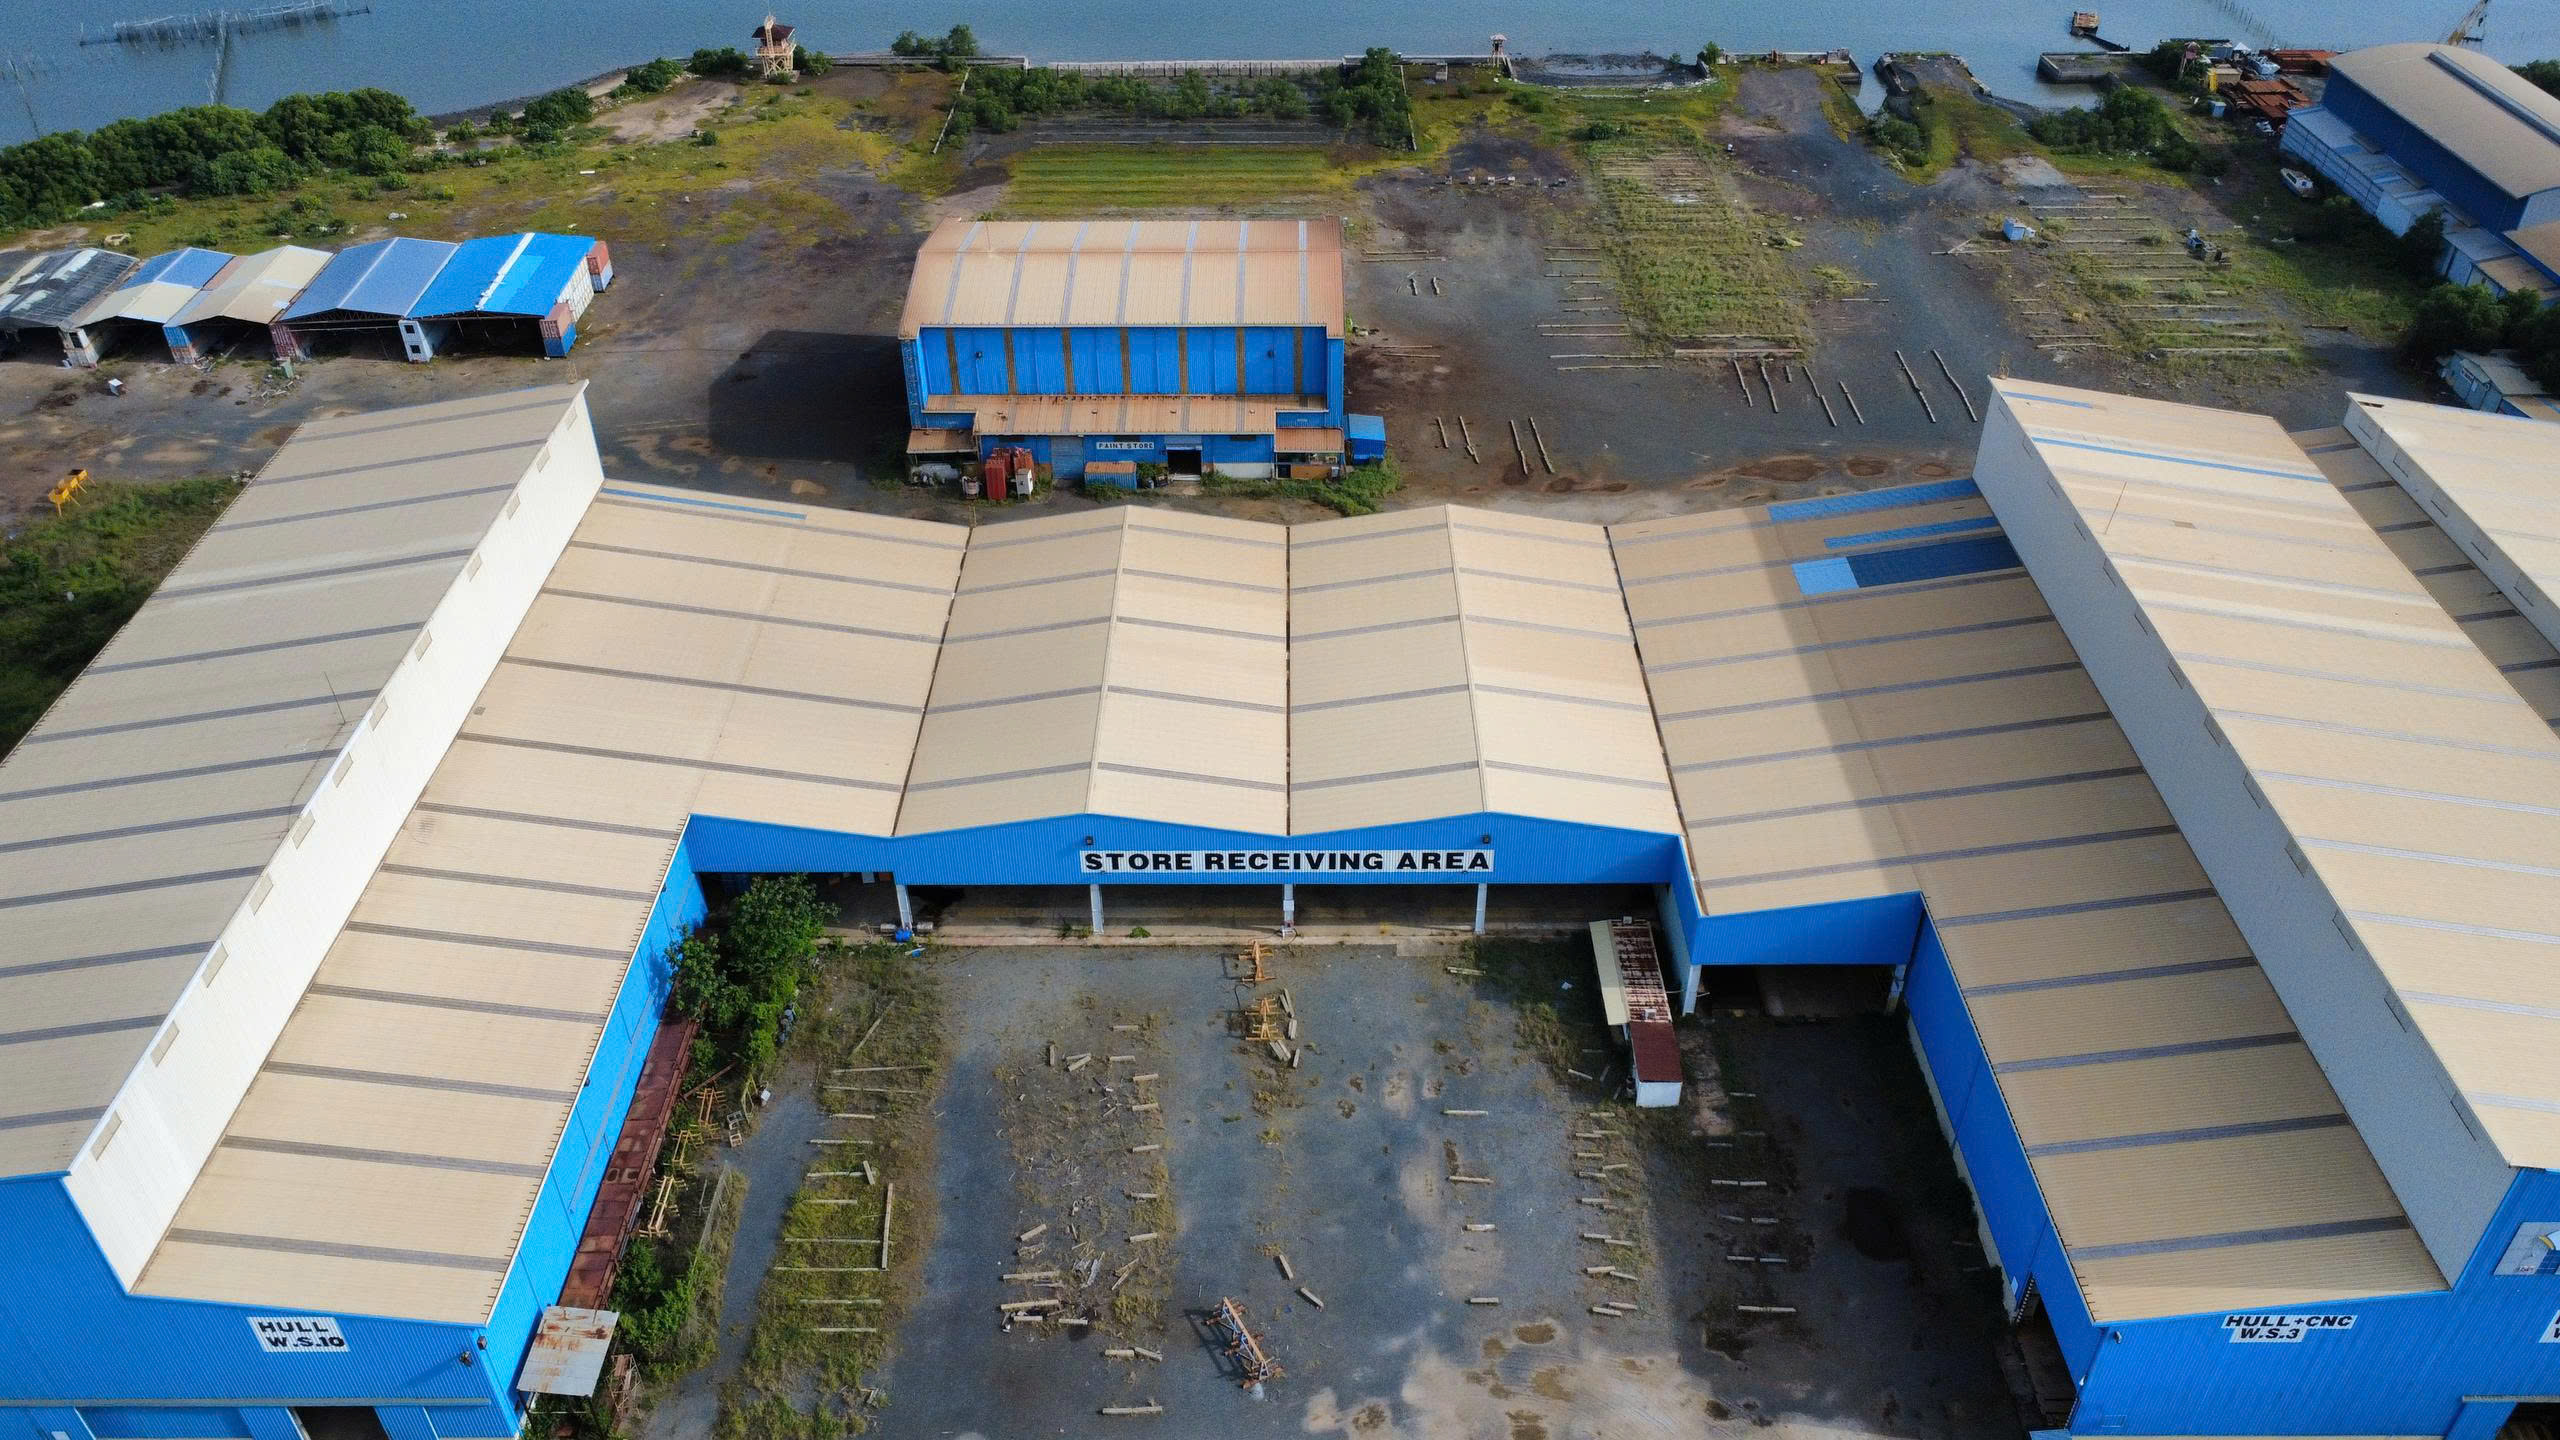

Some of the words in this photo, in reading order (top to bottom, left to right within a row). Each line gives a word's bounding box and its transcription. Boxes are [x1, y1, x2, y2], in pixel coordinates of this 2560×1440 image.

[1084, 852, 1193, 870] STORE
[1204, 852, 1384, 870] RECEIVING
[1396, 851, 1490, 870] AREA
[258, 1321, 328, 1333] HULL
[2225, 1315, 2353, 1327] HULL+CNC
[2240, 1327, 2300, 1339] W.S.3
